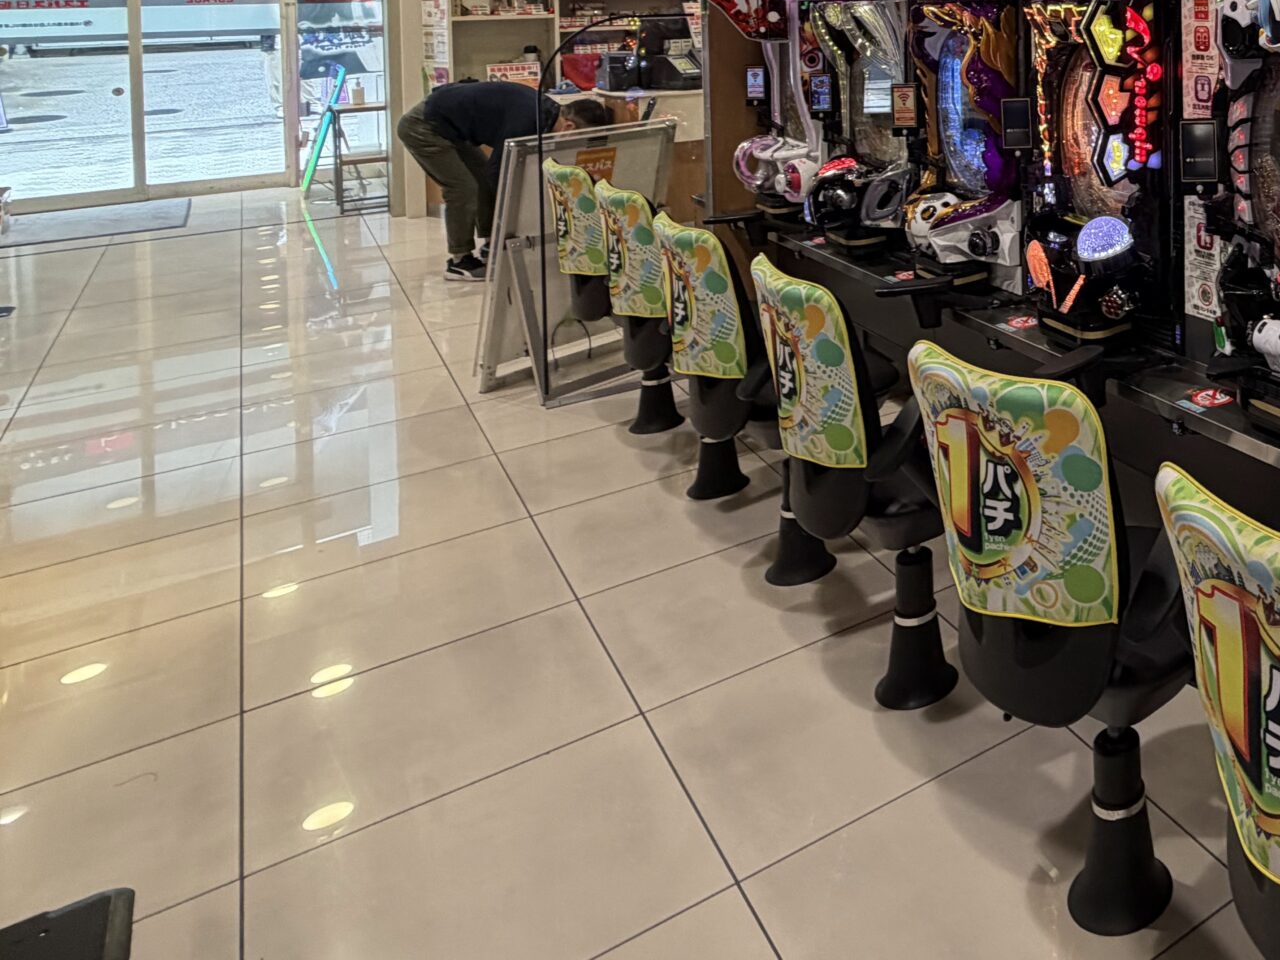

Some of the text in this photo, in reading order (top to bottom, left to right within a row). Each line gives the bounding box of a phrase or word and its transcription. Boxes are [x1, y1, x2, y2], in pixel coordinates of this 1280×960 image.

[672, 278, 688, 323] パチ
[776, 339, 795, 397] パチ
[935, 415, 1015, 538] 1 パチ
[1195, 585, 1250, 764] 1
